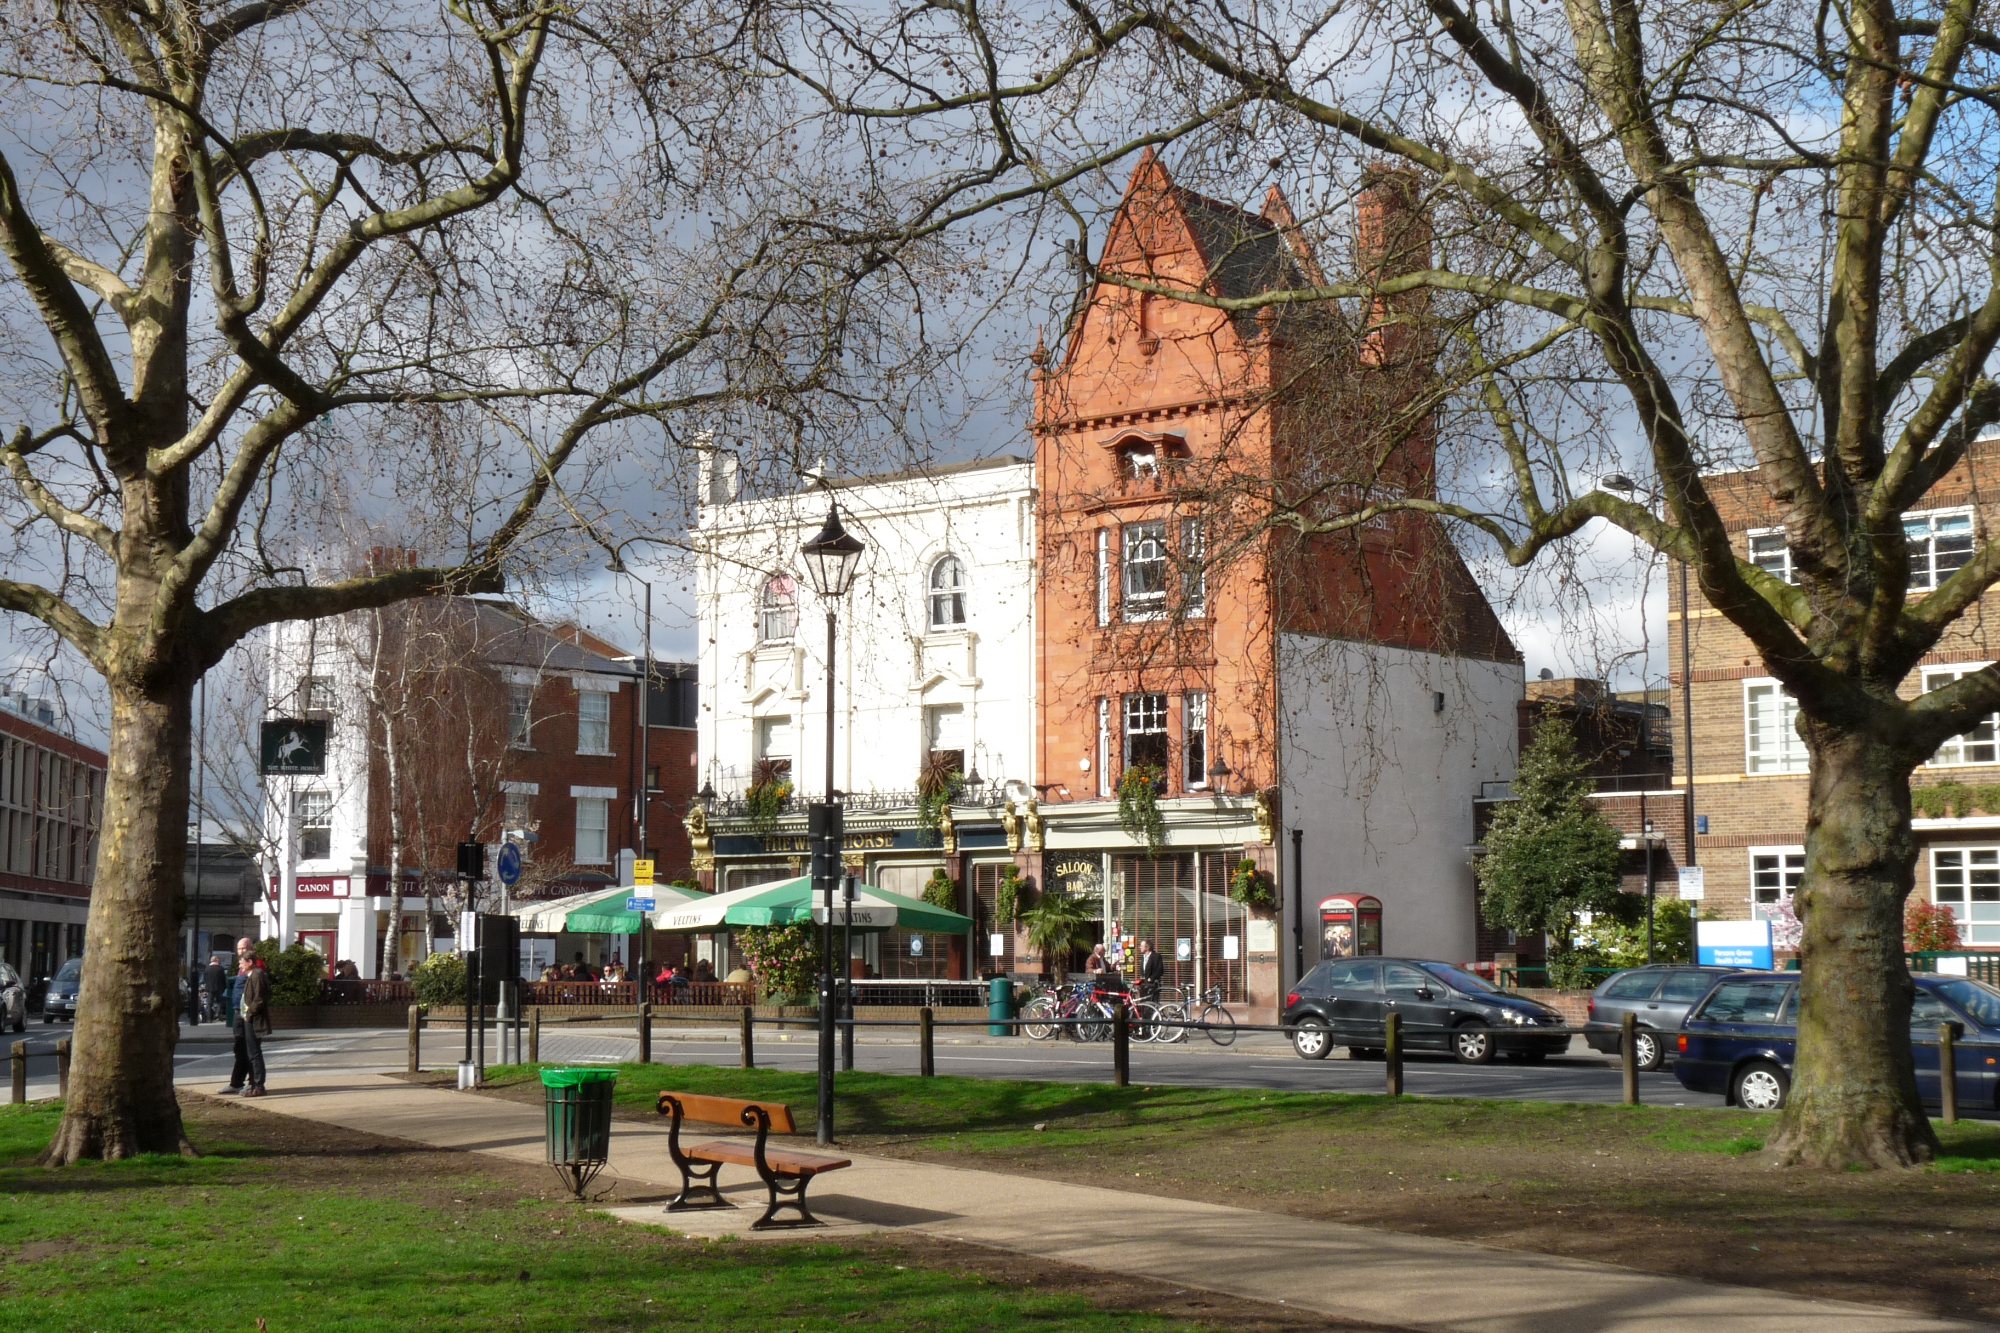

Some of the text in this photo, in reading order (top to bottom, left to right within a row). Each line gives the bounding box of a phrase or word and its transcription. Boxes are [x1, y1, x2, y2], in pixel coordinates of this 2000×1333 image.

[763, 835, 791, 852] THE
[842, 832, 894, 849] HORSE
[1055, 861, 1093, 877] SALOON
[298, 883, 330, 892] CANON
[673, 915, 702, 926] VELTINS
[839, 911, 873, 923] VLTINS
[519, 919, 544, 929] ELTINS
